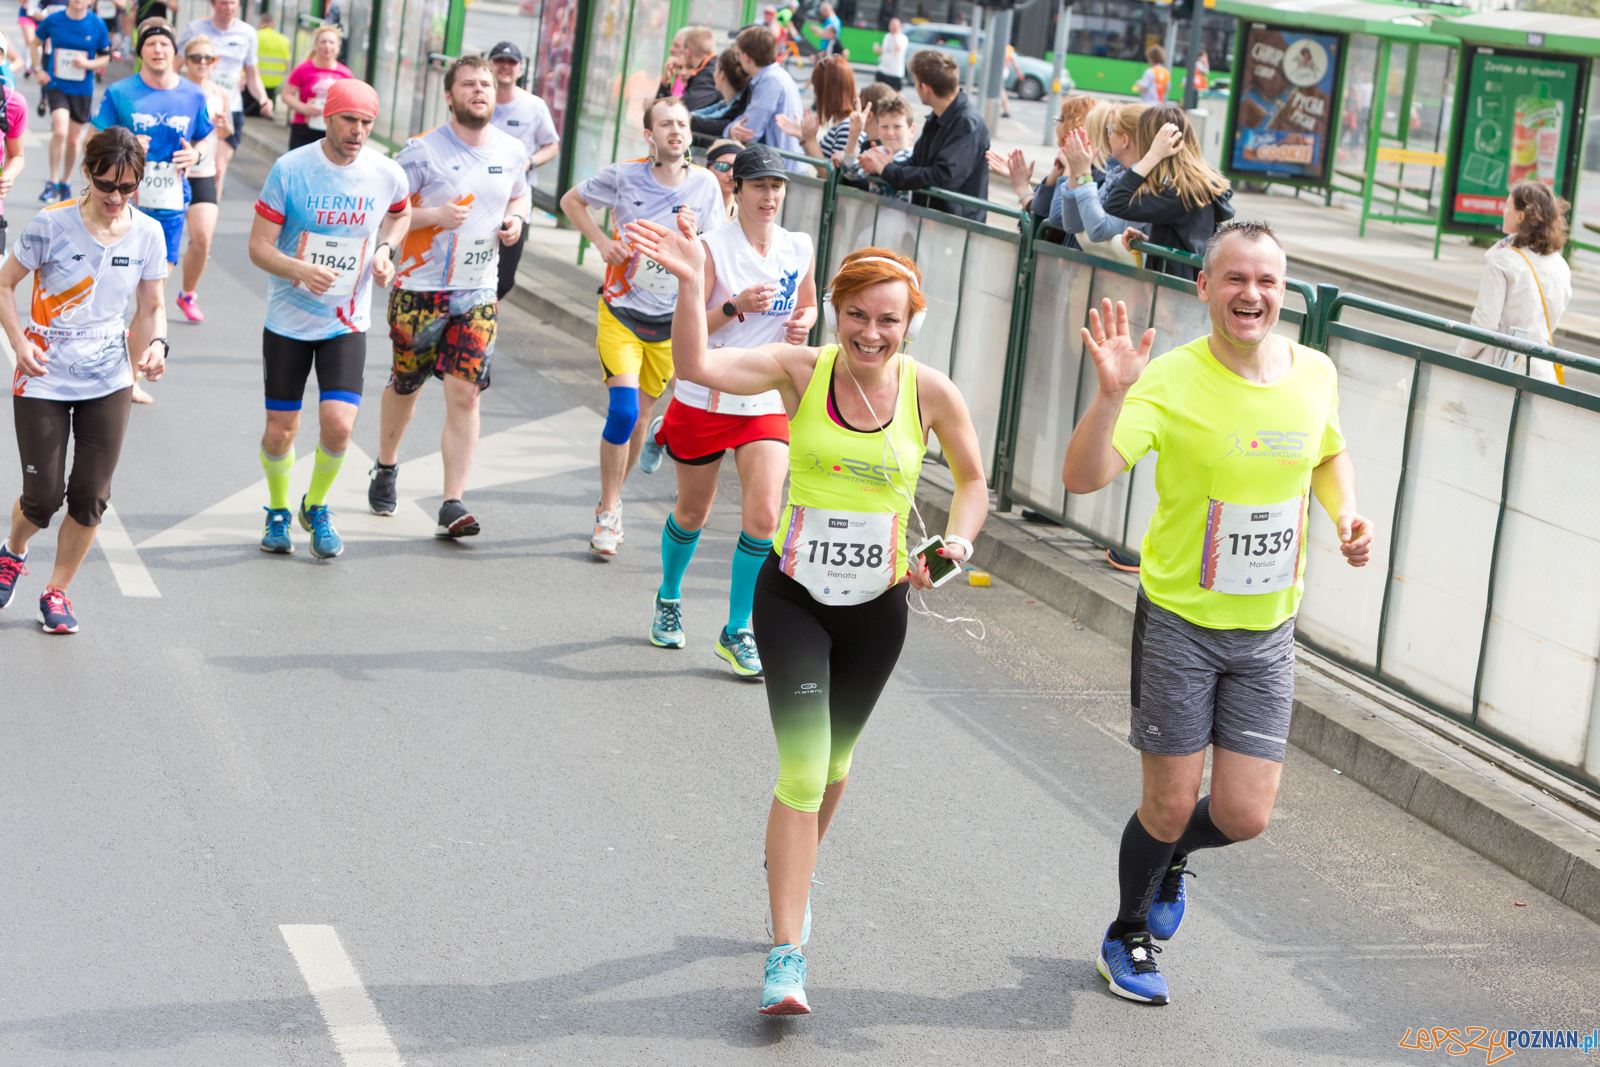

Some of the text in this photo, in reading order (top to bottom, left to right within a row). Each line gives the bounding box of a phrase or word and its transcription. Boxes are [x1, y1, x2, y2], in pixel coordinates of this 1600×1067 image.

[145, 176, 175, 188] 9019
[306, 194, 376, 211] HERNIK
[316, 210, 366, 226] TEAM
[310, 252, 357, 271] 11842
[463, 248, 494, 265] 2193
[1244, 450, 1302, 459] ARCHITEKTURA
[825, 471, 887, 488] ARCHITEKTURA
[859, 485, 883, 494] TEAM
[1228, 527, 1294, 557] 11339
[808, 539, 884, 569] 11338
[1249, 560, 1276, 568] Mariusz
[827, 570, 857, 580] Renata
